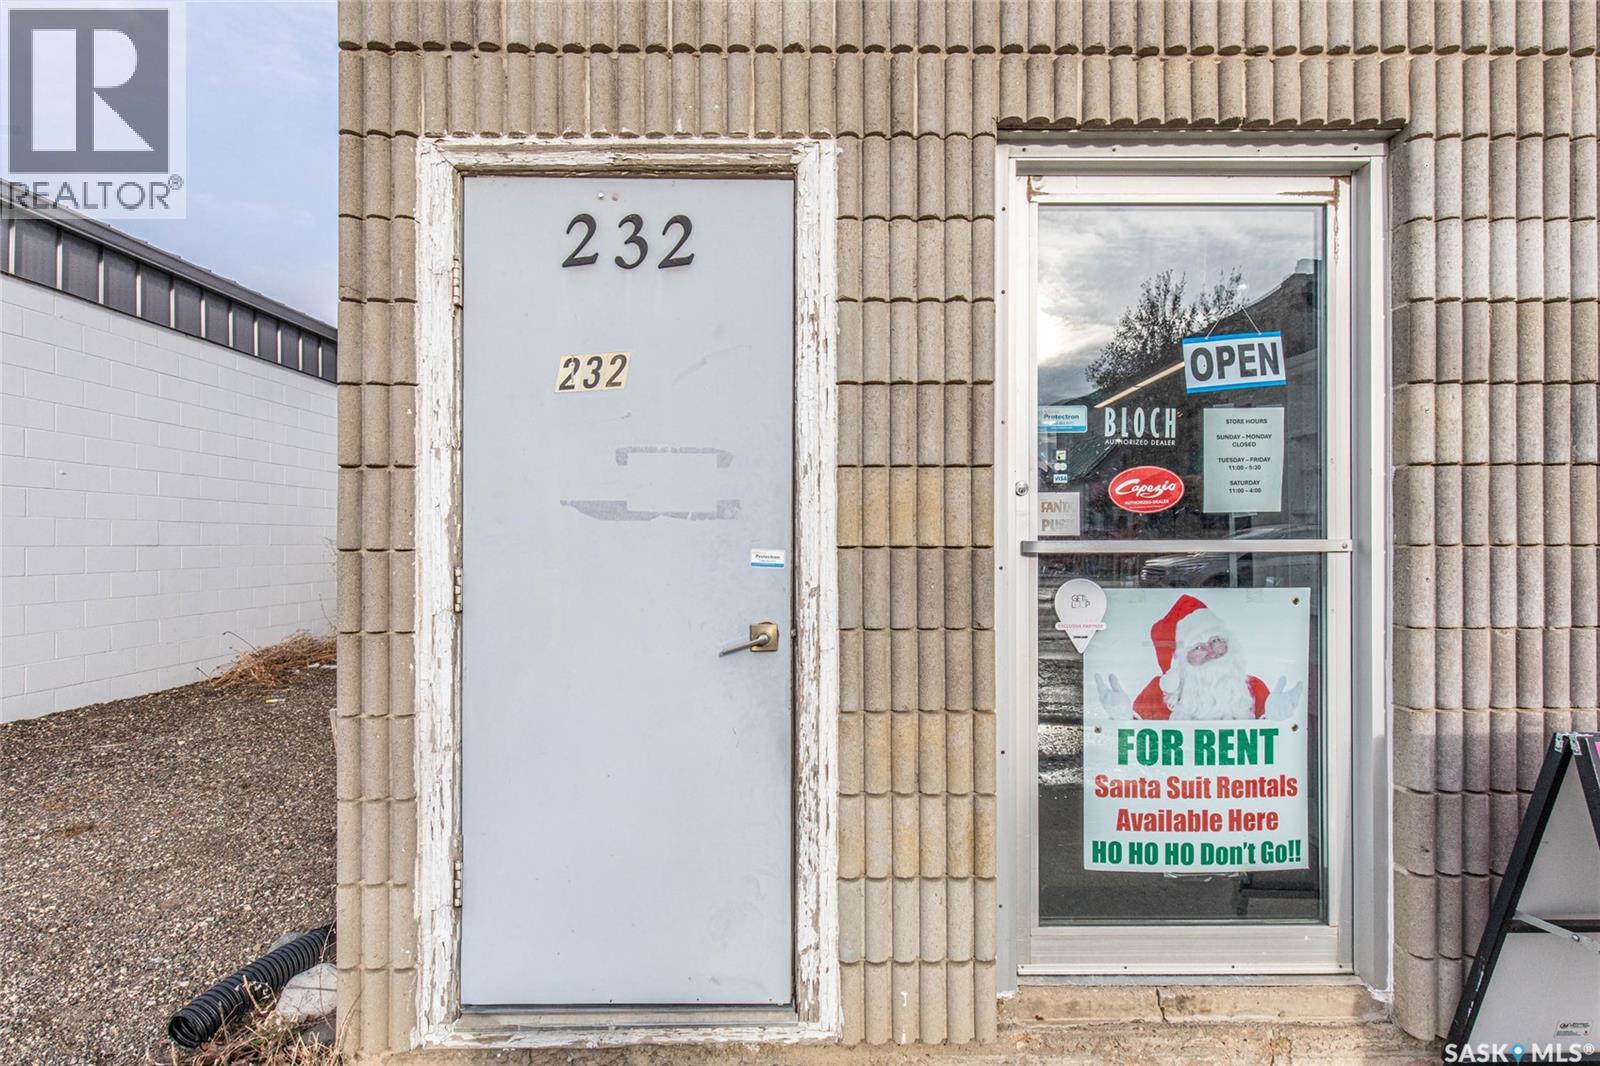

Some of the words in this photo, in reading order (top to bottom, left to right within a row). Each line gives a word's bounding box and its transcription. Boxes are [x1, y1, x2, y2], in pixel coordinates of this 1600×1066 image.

[561, 213, 695, 270] 232
[558, 354, 628, 391] 232
[1190, 342, 1280, 382] OPEN
[1043, 413, 1080, 421] Protectron
[1104, 407, 1176, 438] BLOCH
[1115, 478, 1177, 499] Capezio
[1117, 728, 1184, 767] FOR
[1194, 728, 1279, 766] RENT
[1094, 774, 1161, 799] Santa
[1166, 776, 1211, 800] Suit
[1216, 774, 1298, 799] Rentals
[1116, 808, 1223, 833] Available
[1228, 809, 1279, 832] Here
[1092, 840, 1122, 865] HO
[1128, 842, 1158, 865] HO
[1165, 842, 1195, 866] HO
[1200, 841, 1256, 866] Don't
[1260, 839, 1302, 864] Go!!
